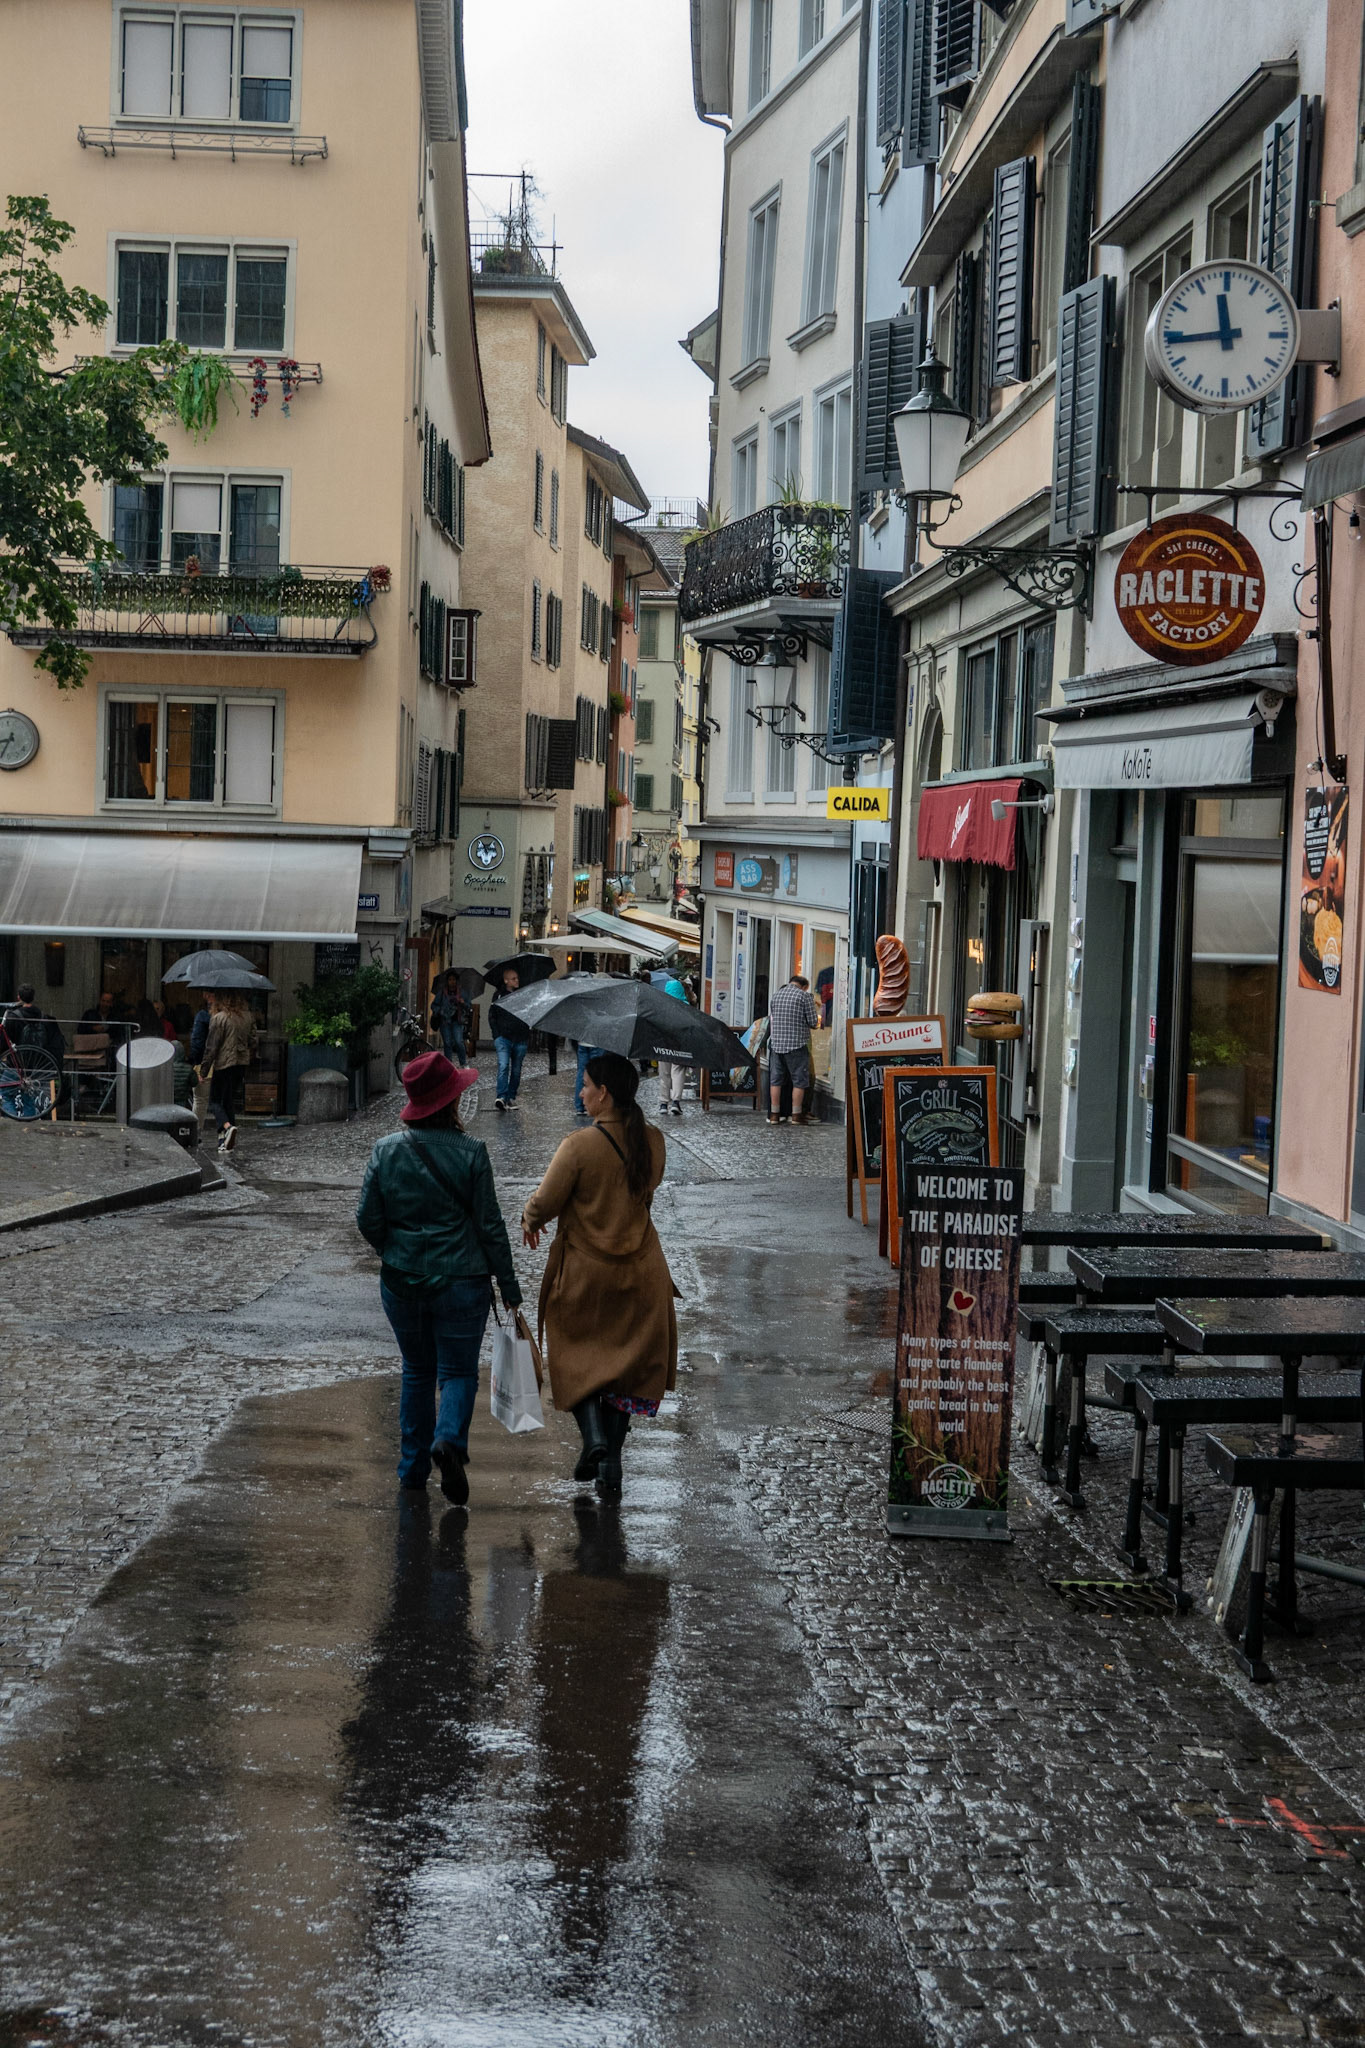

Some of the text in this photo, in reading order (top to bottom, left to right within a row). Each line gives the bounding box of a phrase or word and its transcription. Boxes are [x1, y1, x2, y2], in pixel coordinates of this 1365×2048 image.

[1166, 541, 1218, 556] SAY CHEESE
[1119, 569, 1260, 613] RACLETTE
[1149, 611, 1230, 641] FACTORY
[833, 796, 880, 812] CALIDA
[464, 873, 506, 886] Spaghetti
[741, 873, 758, 884] BAR
[358, 897, 376, 906] statt
[875, 1024, 932, 1044] Brunne
[920, 1088, 961, 1112] GRILL
[918, 1175, 1013, 1201] WELCOME TO
[909, 1210, 1018, 1236] THE PARADISE
[921, 1246, 1003, 1271] OF CHEESE
[902, 1333, 1011, 1352] Many types of cheese,
[908, 1354, 1003, 1371] large tarte flambée
[900, 1376, 1009, 1394] and probably the best
[908, 1397, 999, 1413] garlic bread in the
[938, 1419, 966, 1432] world.
[921, 1479, 976, 1497] RACLETTE
[933, 1495, 964, 1507] FACTORY
